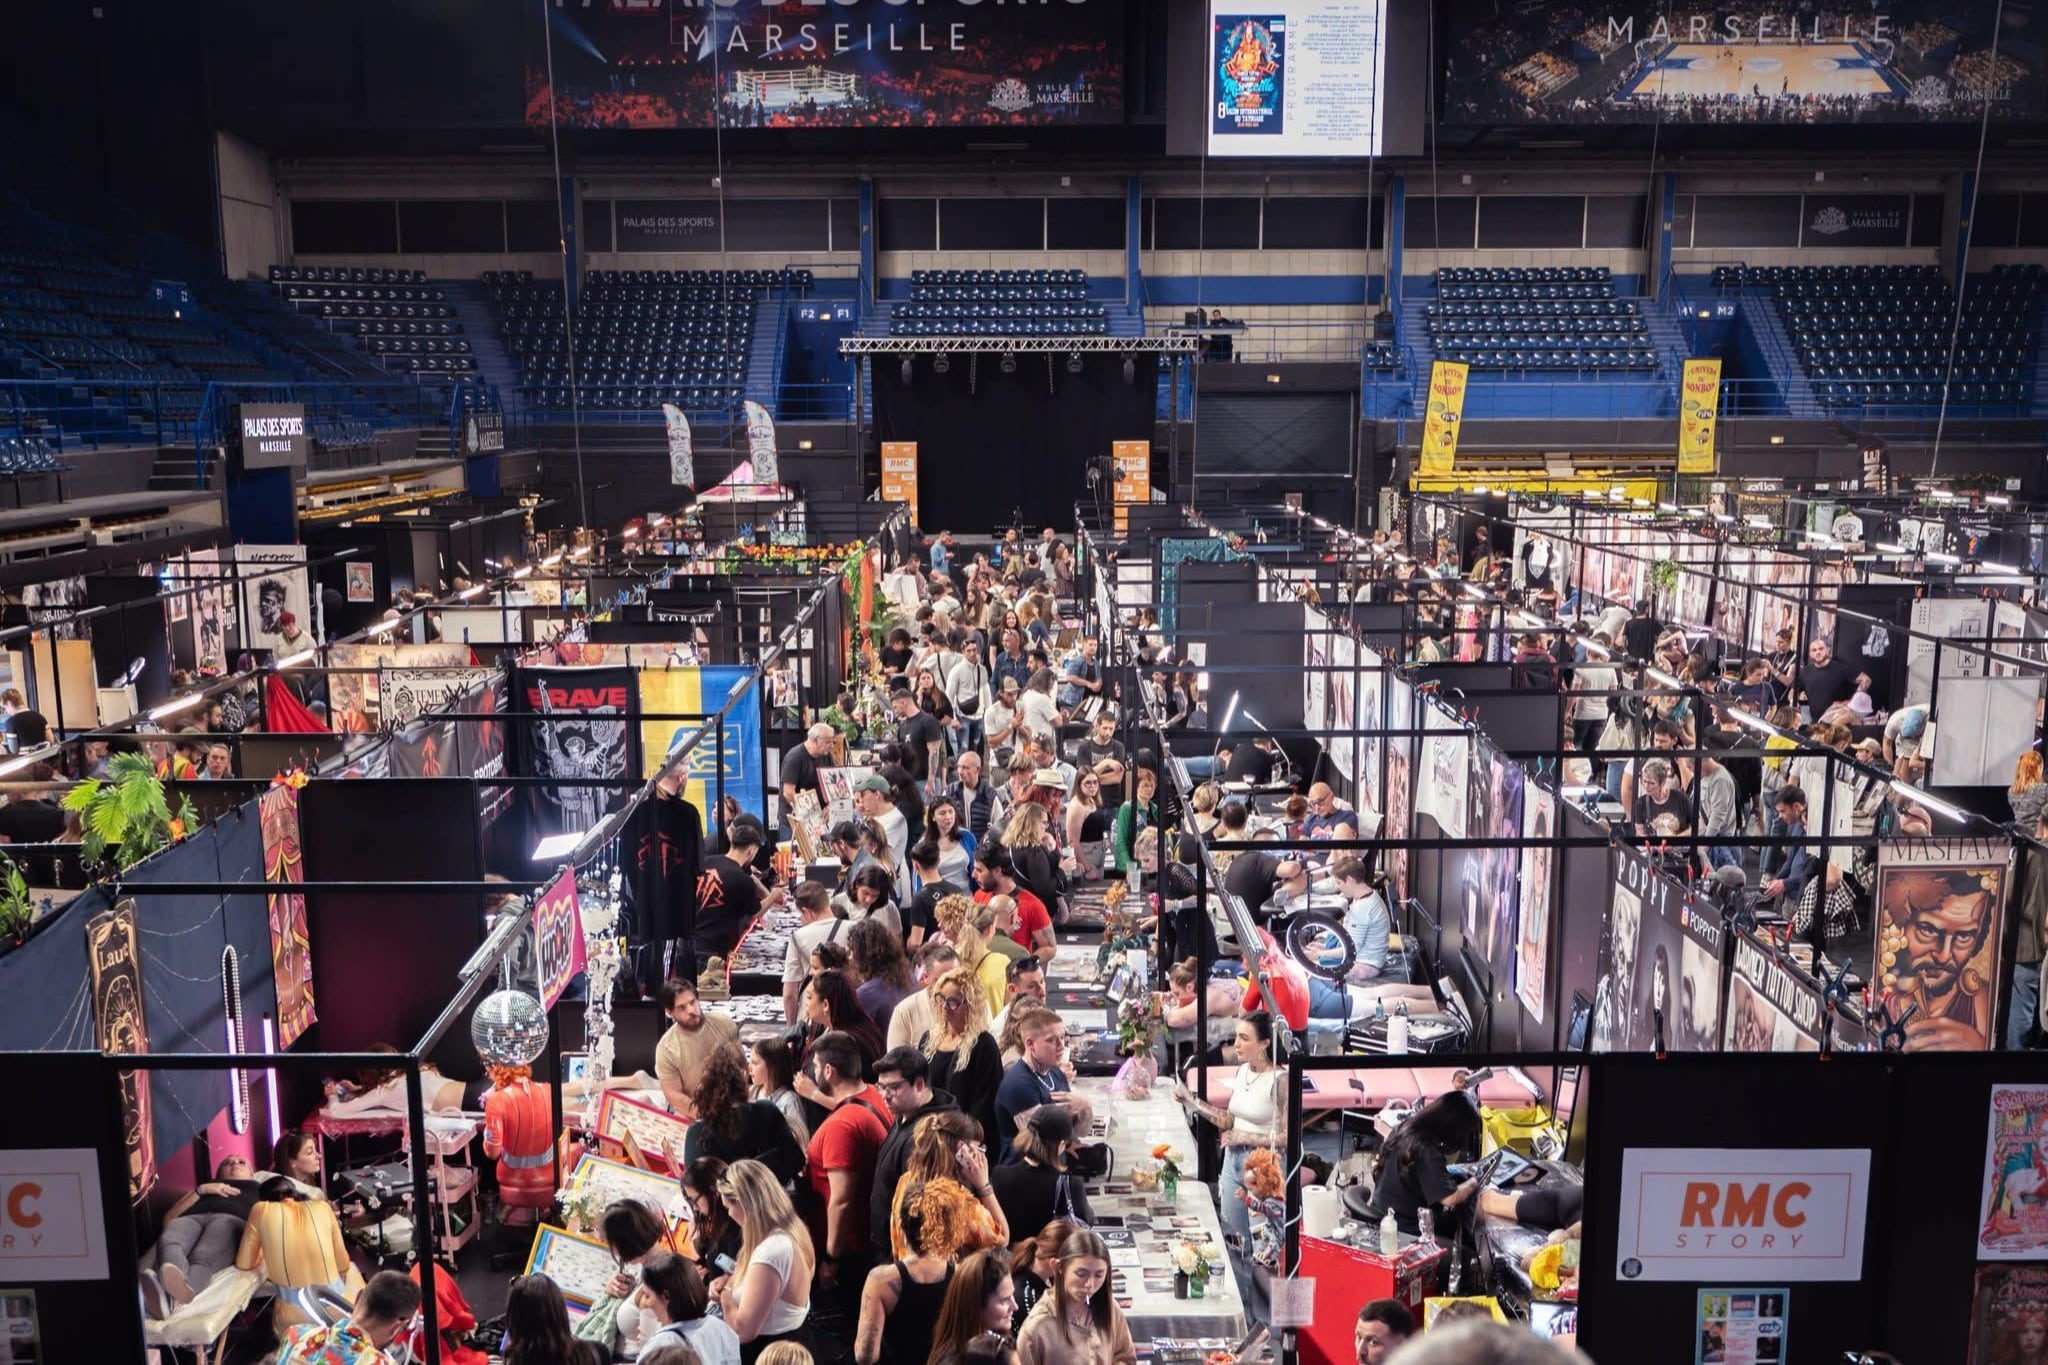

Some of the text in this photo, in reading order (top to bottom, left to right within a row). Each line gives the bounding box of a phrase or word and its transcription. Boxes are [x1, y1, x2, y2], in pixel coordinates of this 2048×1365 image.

[683, 23, 966, 52] MARSEILLE
[1607, 16, 1889, 43] MARSEILLE
[1036, 92, 1094, 103] MARSEILLE
[1218, 102, 1226, 119] 8
[623, 217, 714, 228] PALAIS DES SPORTS
[801, 309, 816, 319] F2
[837, 309, 850, 319] F1
[1717, 306, 1735, 316] M2
[244, 416, 303, 437] PALAIS DES SPORTS
[260, 440, 292, 453] MARSEILLE
[527, 687, 627, 707] BRAVE
[1617, 850, 1669, 916] POPPY
[1765, 961, 1796, 1015] TATTOO
[1793, 986, 1818, 1033] SHOP
[1679, 1181, 1812, 1229] RMC
[1675, 1233, 1805, 1249] STORY
